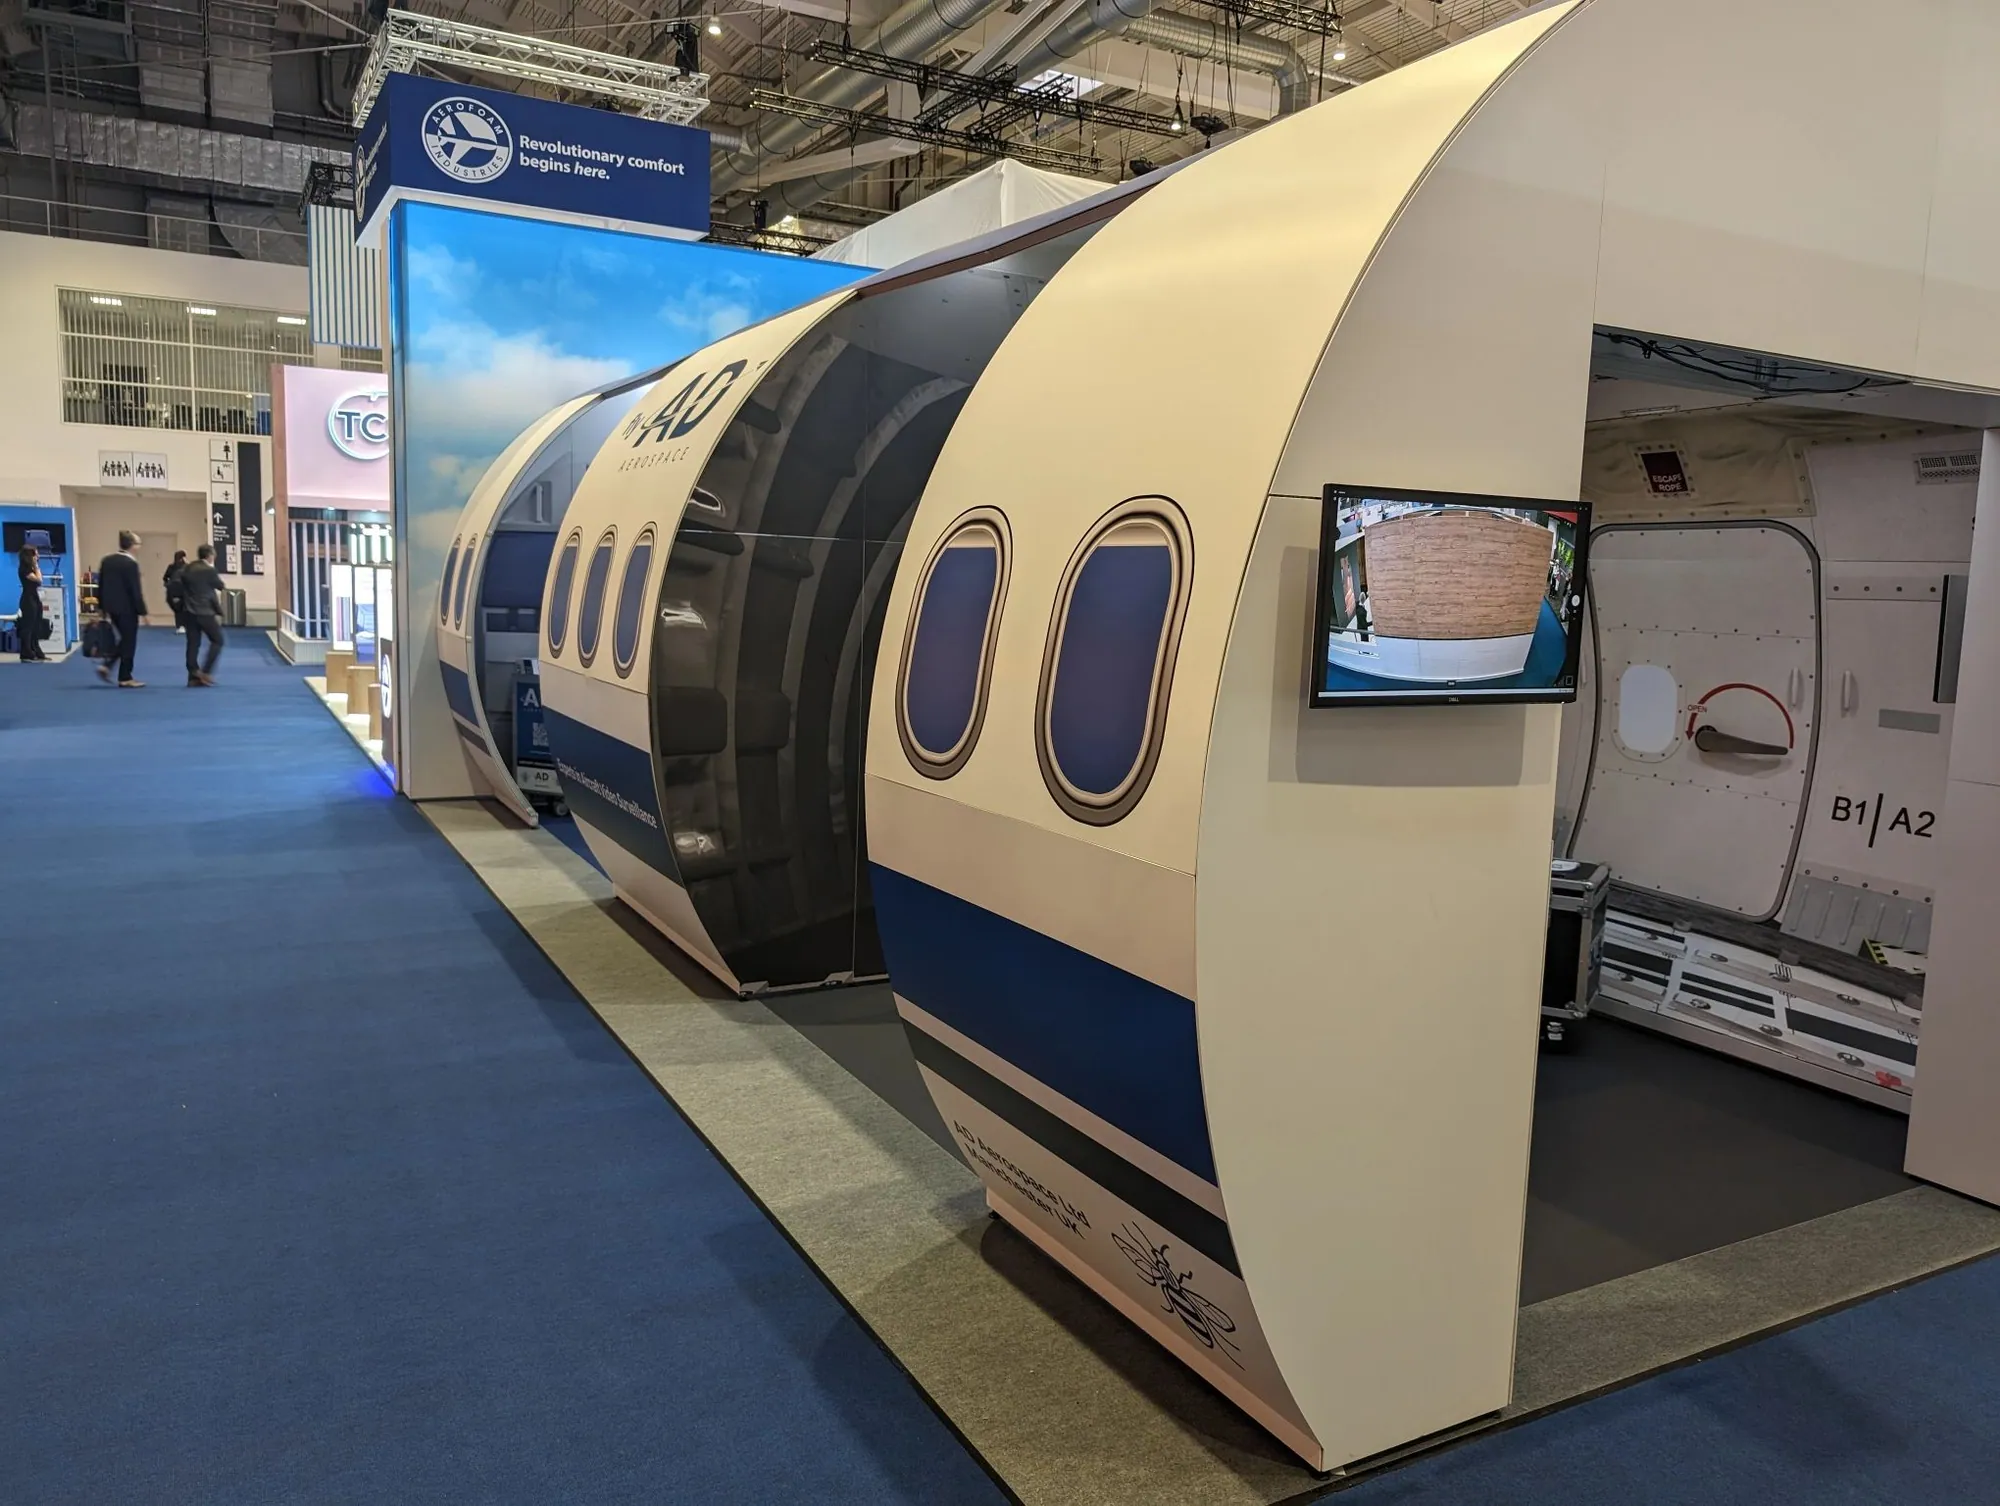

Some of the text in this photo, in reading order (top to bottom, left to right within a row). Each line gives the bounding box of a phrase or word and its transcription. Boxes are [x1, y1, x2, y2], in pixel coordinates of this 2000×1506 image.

[432, 103, 504, 135] AEROFOAM
[431, 144, 504, 178] INDUSTRIES
[520, 135, 685, 176] Revolutionary comfort
[520, 152, 610, 180] begins here.
[618, 446, 690, 472] AEROSPACE
[1652, 473, 1683, 483] ESCAPE
[1658, 483, 1683, 491] ROPE
[1687, 704, 1708, 713] OPEN
[1831, 795, 1936, 838] B1 A2
[954, 1120, 1092, 1230] AD Aerospace Ltd
[964, 1142, 1086, 1240] Manchester UK
